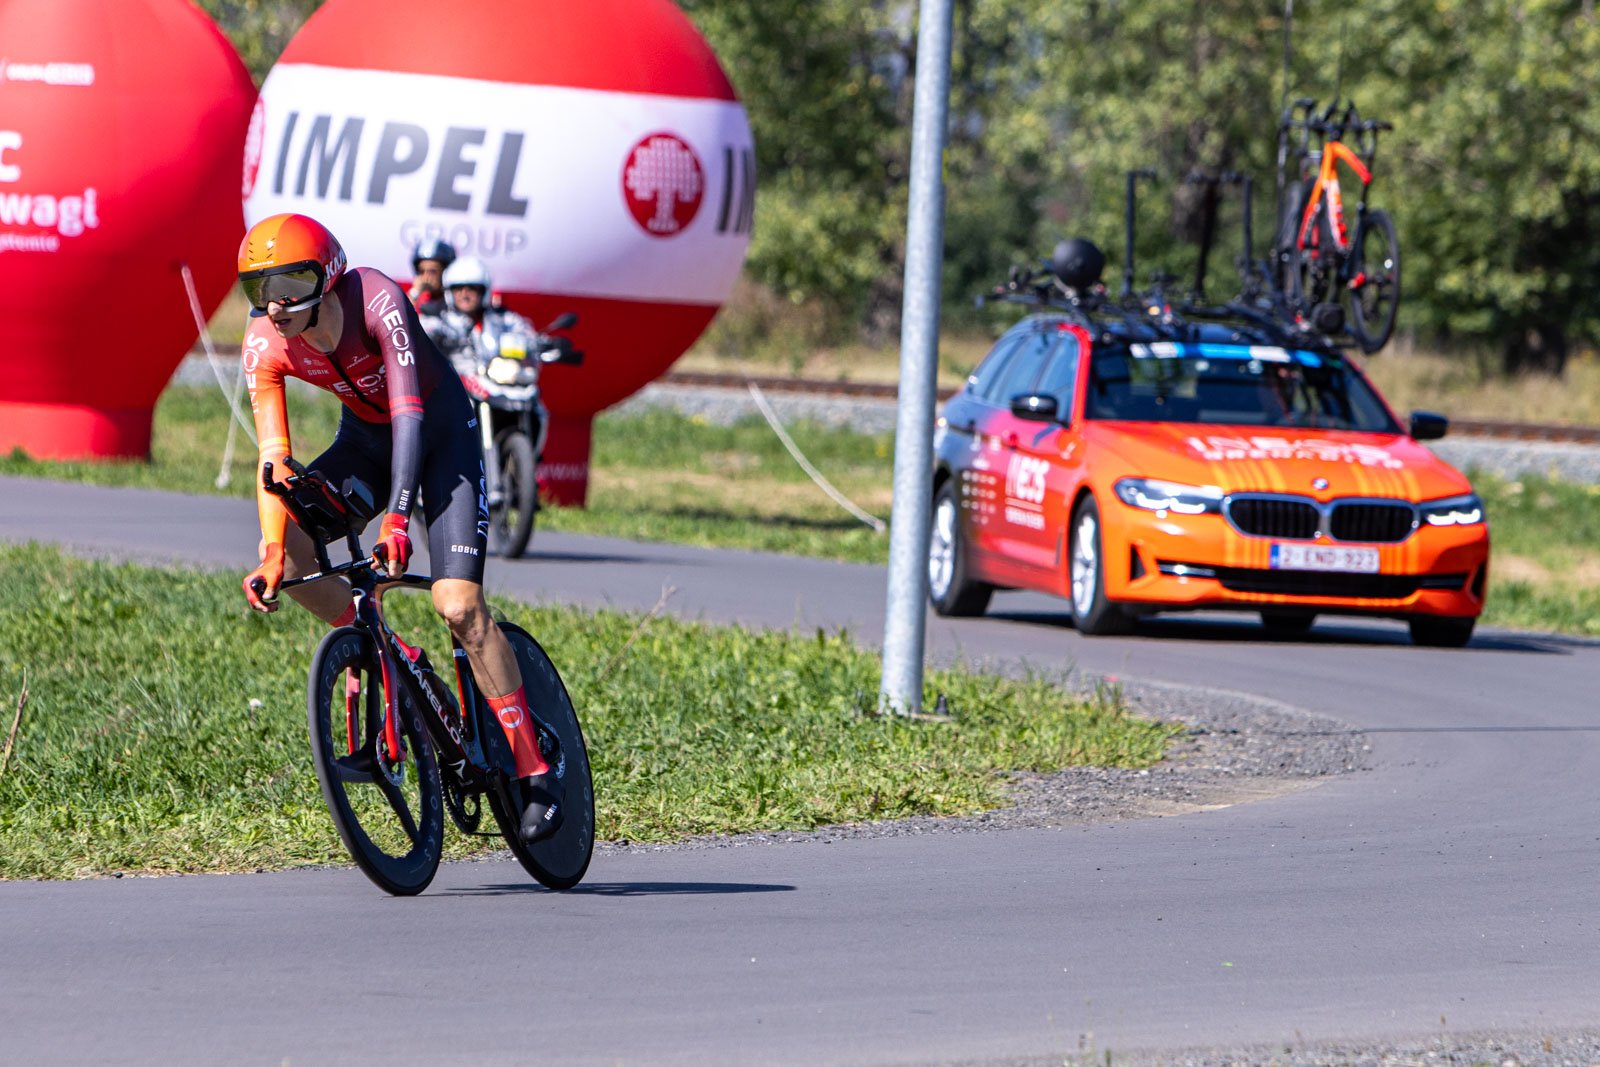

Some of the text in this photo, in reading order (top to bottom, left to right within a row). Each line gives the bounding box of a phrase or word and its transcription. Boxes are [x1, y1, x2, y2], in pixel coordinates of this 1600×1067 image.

[272, 111, 532, 218] IMPEL
[399, 219, 532, 258] GROUP
[366, 289, 415, 367] INEOS
[398, 488, 410, 511] GOBIK
[451, 544, 479, 556] GOBIK
